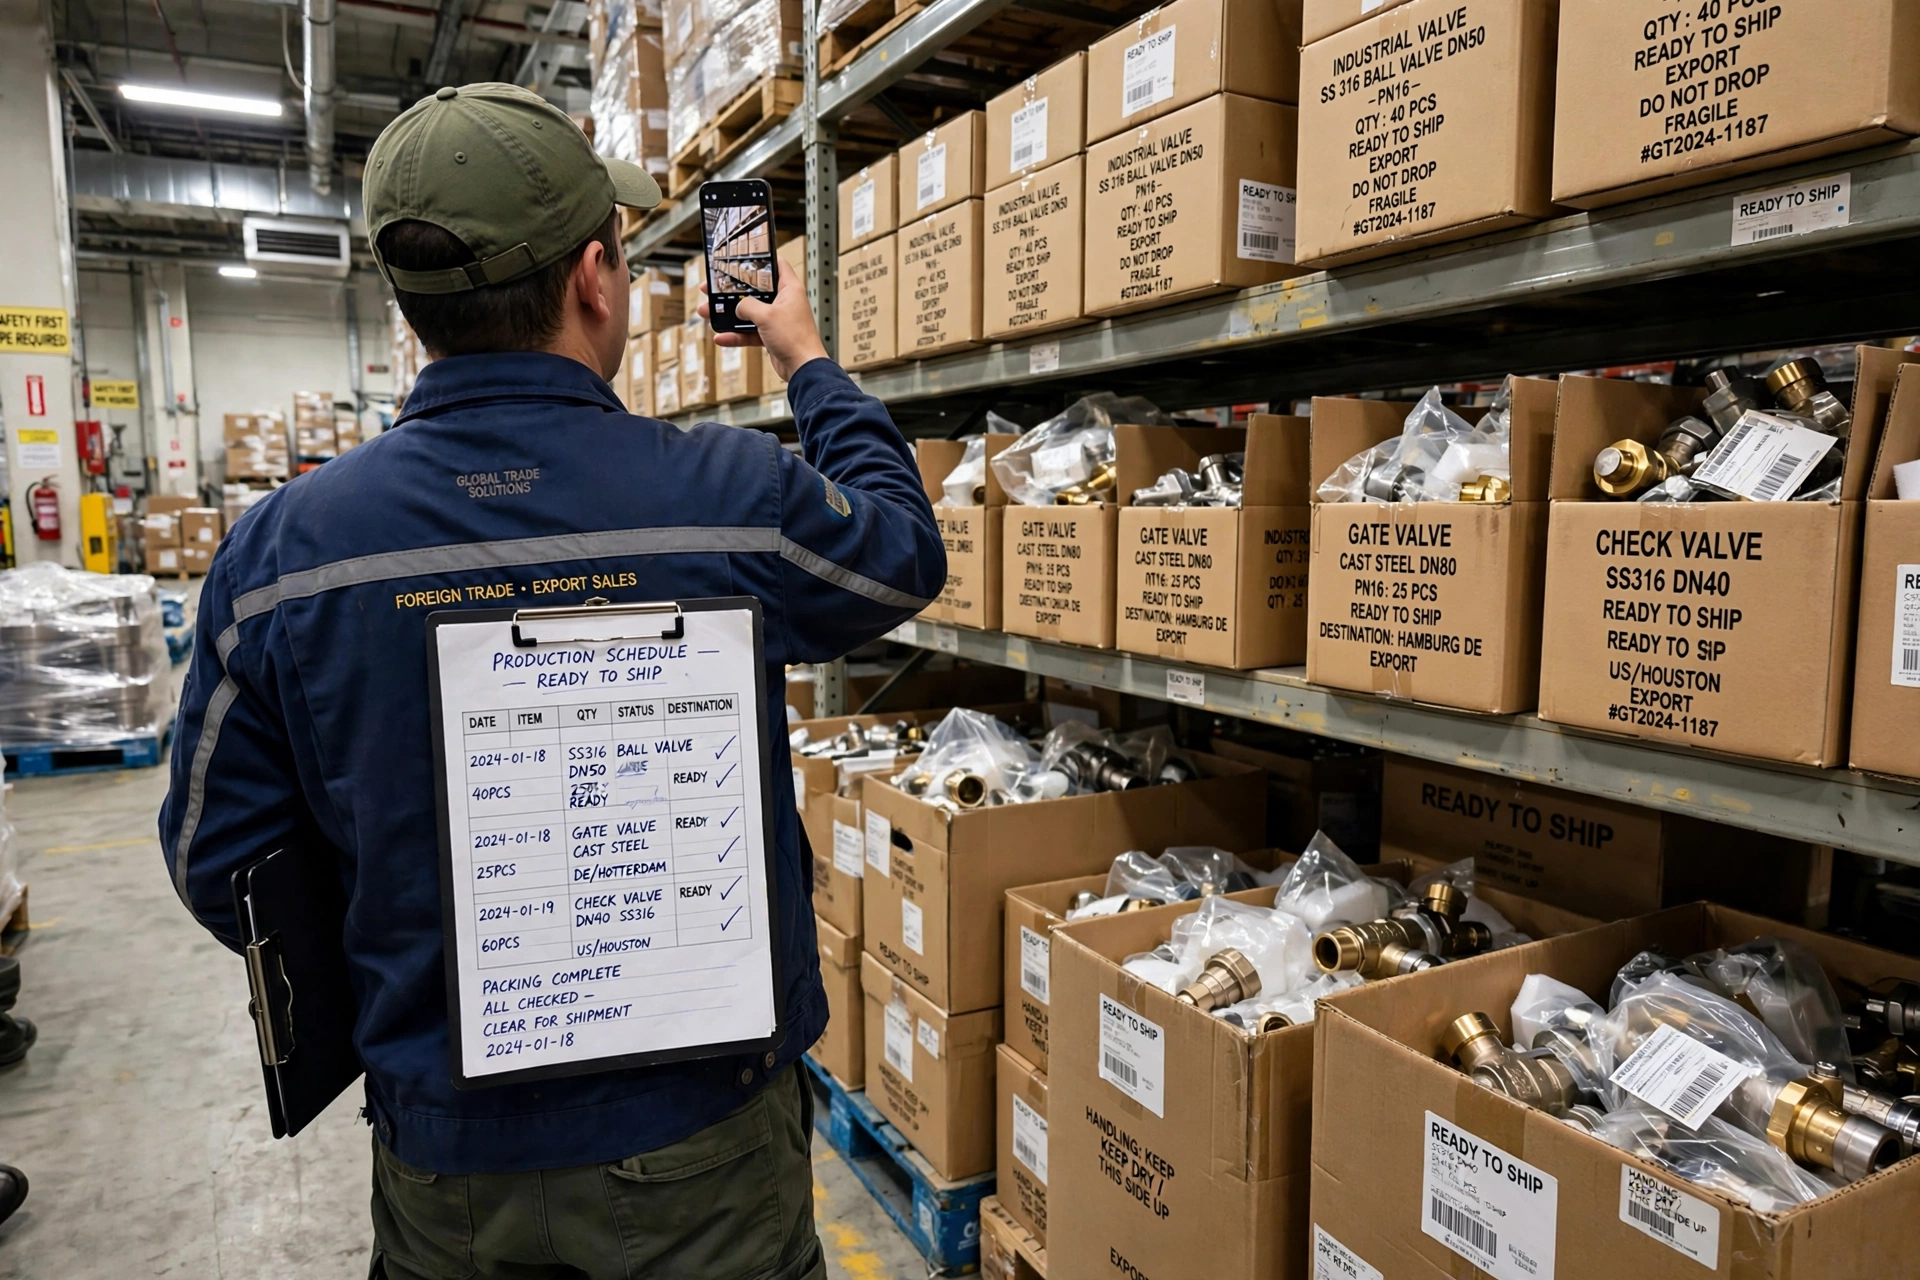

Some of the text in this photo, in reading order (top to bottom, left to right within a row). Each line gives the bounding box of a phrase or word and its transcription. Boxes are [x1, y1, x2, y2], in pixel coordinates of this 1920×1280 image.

[1333, 7, 1467, 76] INDUSTRIAL VALVE
[1635, 6, 1781, 70] READY TO SHIP
[1321, 26, 1485, 104] SS 316 BALL VALVE DN50
[1666, 45, 1740, 85] EXPORT
[1640, 64, 1769, 117] DO NOT DROP
[1390, 105, 1404, 122] 40
[1410, 93, 1436, 117] PCS
[1665, 99, 1738, 134] FRAGILE
[1161, 128, 1192, 153] VALVE
[1349, 114, 1444, 159] READY TO SHIP
[1641, 115, 1768, 163] #GT2024-1187
[1369, 144, 1418, 174] EXPORT
[1353, 161, 1436, 198] DO NOT DROP
[1156, 193, 1173, 210] PCS
[1243, 185, 1283, 202] READY TO
[1369, 187, 1417, 214] FRAGILE
[1740, 184, 1841, 217] READY TO SHIP
[1158, 210, 1177, 227] SHIP
[1354, 202, 1435, 236] #GT2024-1187
[36, 316, 63, 328] FIRST
[16, 332, 67, 347] REQUIRED
[457, 468, 540, 487] GLOBAL TRADE
[468, 482, 531, 498] SOLUTIONS
[1022, 521, 1076, 538] GATE VALVE
[1140, 527, 1207, 546] GATE VALVE
[1349, 523, 1451, 547] GATE VALVE
[1596, 530, 1762, 560] CHECK VALVE
[1135, 551, 1185, 567] CAST STEEL
[1340, 553, 1457, 575] CAST STEEL DN80
[395, 573, 637, 609] FOREIGN TRADE EXPORT SALES
[1183, 575, 1201, 589] PCS
[1355, 579, 1437, 602] PN16: 25 PCS
[1606, 566, 1730, 596] SS316 DN40
[1142, 591, 1203, 609] READY TO SHIP
[1216, 617, 1227, 631] DE
[1351, 603, 1441, 626] READY TO SHIP
[1603, 599, 1742, 630] READY TO SHIP
[1156, 628, 1187, 644] EXPORT
[1320, 622, 1482, 656] DESTINATION: HAMBURG DE
[1608, 630, 1661, 654] READY
[1666, 636, 1689, 658] TO
[493, 645, 688, 671] PRODUCTION SCHEDULE
[1370, 650, 1417, 672] EXPORT
[537, 666, 662, 688] READY TO SHIP
[1610, 661, 1720, 693] US/HOUSTON
[1630, 687, 1693, 713] EXPORT
[469, 699, 733, 728] DATE ITEM QTY STATUS DESTINATION
[1609, 704, 1718, 737] #GT2024-1187
[470, 739, 693, 767] 2024-01-18 SS316 BALL VALVE
[569, 764, 606, 779] DN50
[673, 771, 707, 784] READY
[472, 786, 511, 799] 40PCS
[569, 794, 608, 808] READY
[676, 816, 709, 829] READY
[1422, 782, 1614, 849] READY TO SHIP
[474, 820, 656, 848] 2024-01-18 GATE VALVE
[573, 839, 649, 858] CAST STEEL
[477, 863, 516, 879] 25PCS
[680, 885, 712, 898] READY
[479, 889, 663, 921] 2024-01-19 CHECK VALVE
[576, 907, 655, 927] DN40 SS316
[482, 937, 651, 957] 60PCS US/HOUSTON
[483, 965, 621, 995] PACKING COMPLETE
[483, 991, 579, 1015] ALL CHECKED
[483, 1004, 632, 1037] CLEAR FOR SHIPMENT
[1103, 1001, 1158, 1040] READY TO SHIP
[486, 1032, 574, 1058] 2024-01-18
[1086, 1105, 1142, 1159] HANDLING:
[1145, 1148, 1175, 1180] KEEP
[1101, 1136, 1155, 1189] KEEP DRY
[1432, 1122, 1543, 1193] READY TO SHIP
[1098, 1155, 1169, 1220] THIS SIDE UP
